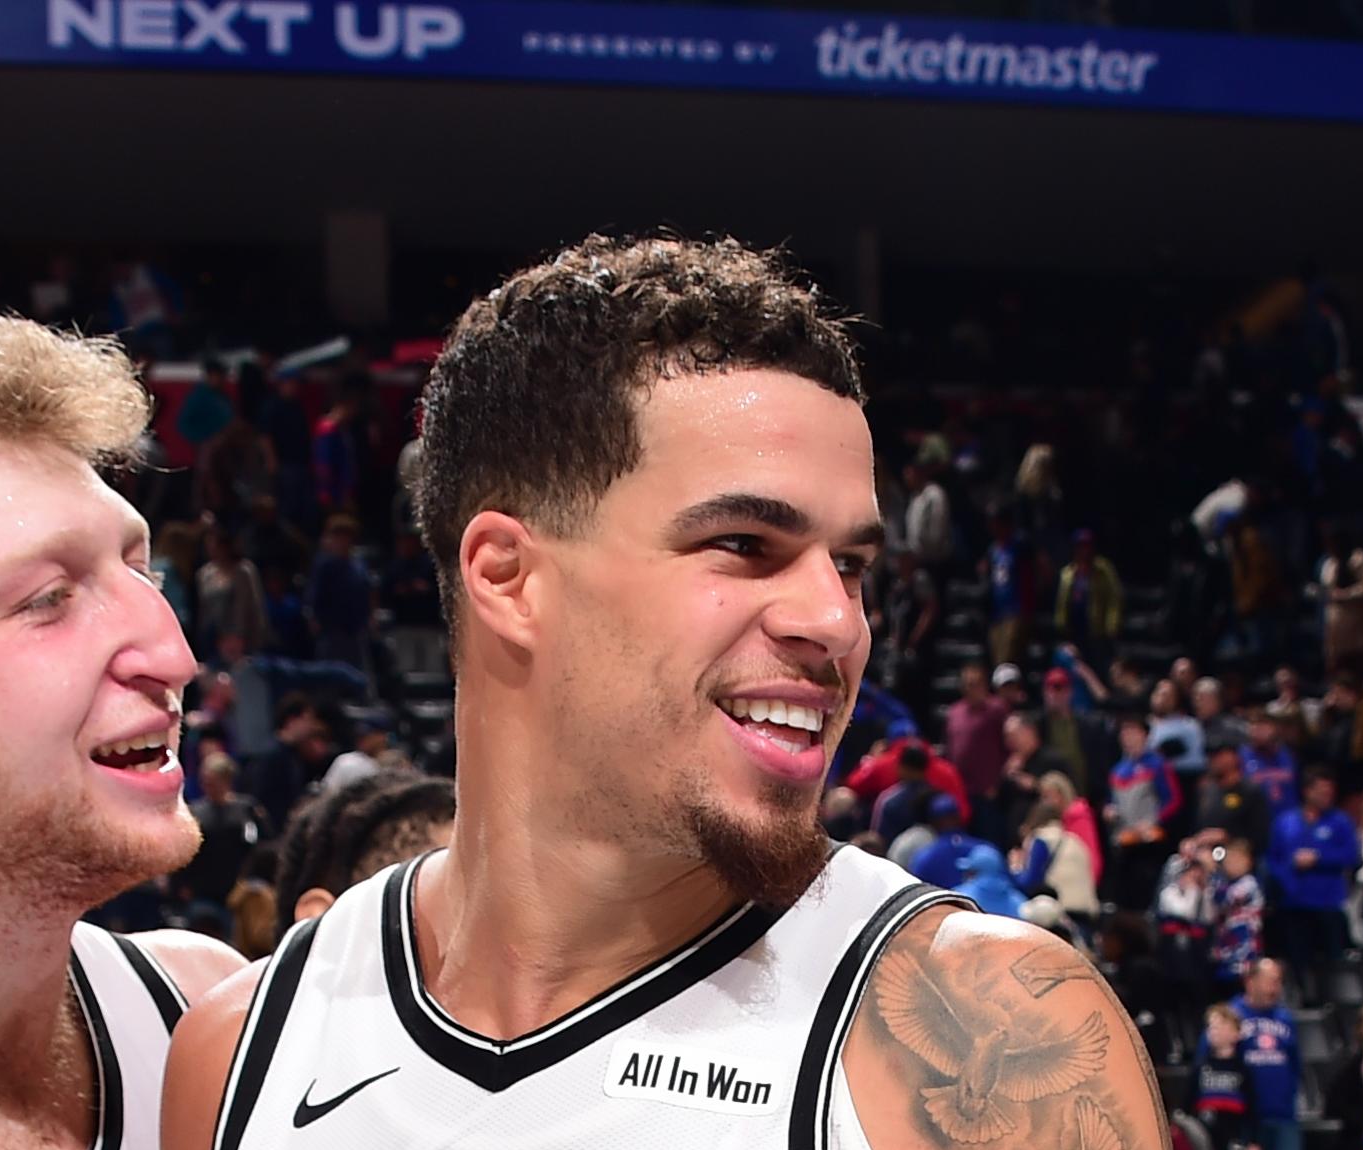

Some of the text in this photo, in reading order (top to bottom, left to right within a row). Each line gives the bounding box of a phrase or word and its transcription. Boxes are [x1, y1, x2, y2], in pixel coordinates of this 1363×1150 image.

[47, 0, 464, 59] NEXT UP
[815, 21, 1157, 92] ticketmaster
[618, 1052, 772, 1105] All In Won
